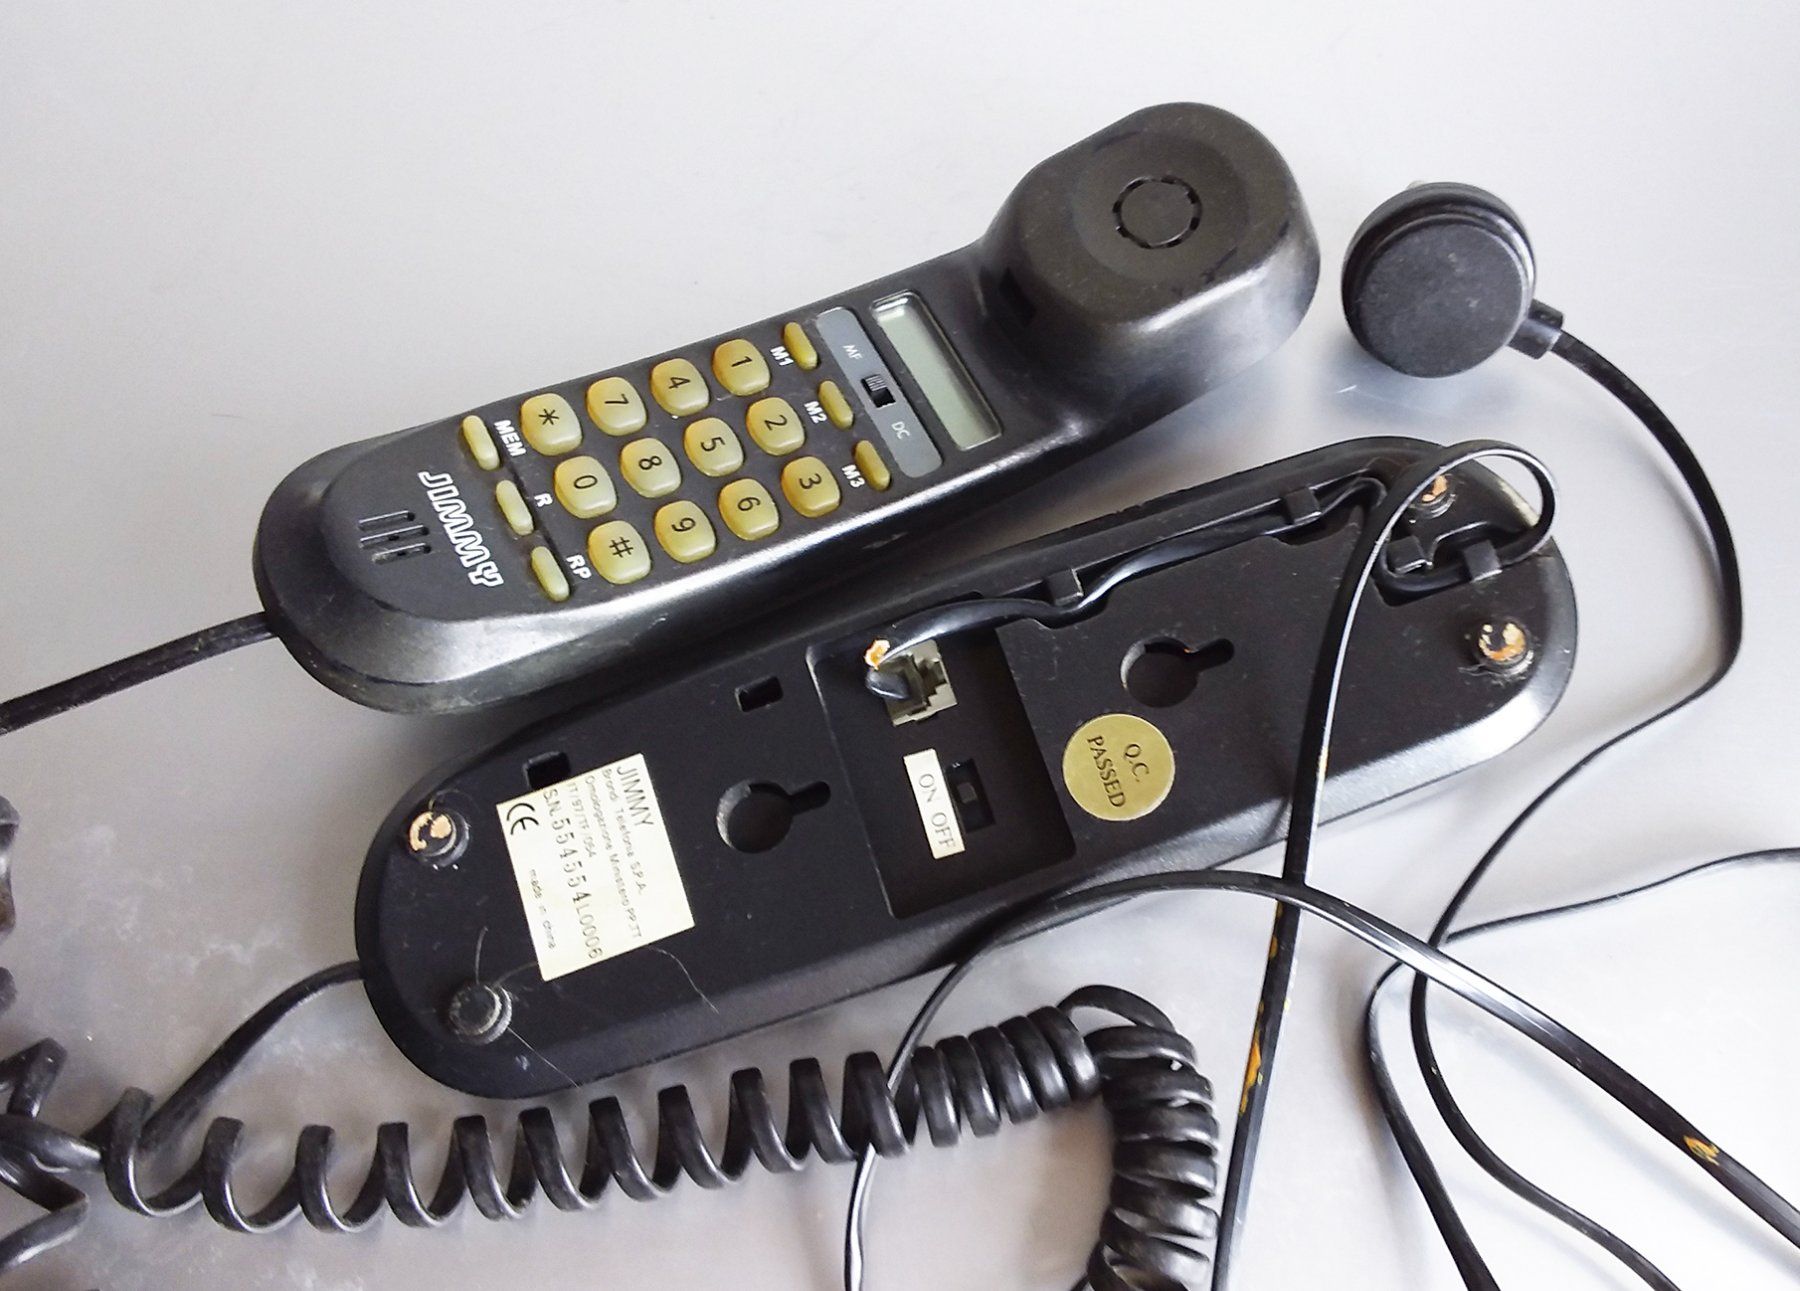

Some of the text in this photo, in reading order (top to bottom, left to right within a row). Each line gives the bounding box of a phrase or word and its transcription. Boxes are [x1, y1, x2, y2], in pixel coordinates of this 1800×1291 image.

[770, 345, 794, 367] M1
[842, 344, 863, 361] MF
[731, 355, 753, 368] 1
[668, 375, 691, 390] 4
[604, 393, 629, 406] 7
[804, 400, 828, 424] M2
[764, 414, 788, 431] 2
[891, 421, 910, 440] DC
[494, 419, 527, 457] MEM
[700, 436, 726, 453] 5
[638, 455, 663, 471] 8
[573, 474, 598, 490] 0
[798, 473, 822, 490] 3
[841, 464, 866, 488] M3
[534, 492, 554, 508] R
[737, 496, 762, 512] 6
[417, 471, 505, 587] JIMMY
[671, 517, 697, 533] 9
[609, 536, 634, 558] #
[566, 554, 592, 580] RP
[1087, 735, 1126, 808] PASSED
[615, 765, 654, 826] JIMMY
[919, 773, 956, 849] ON OFF
